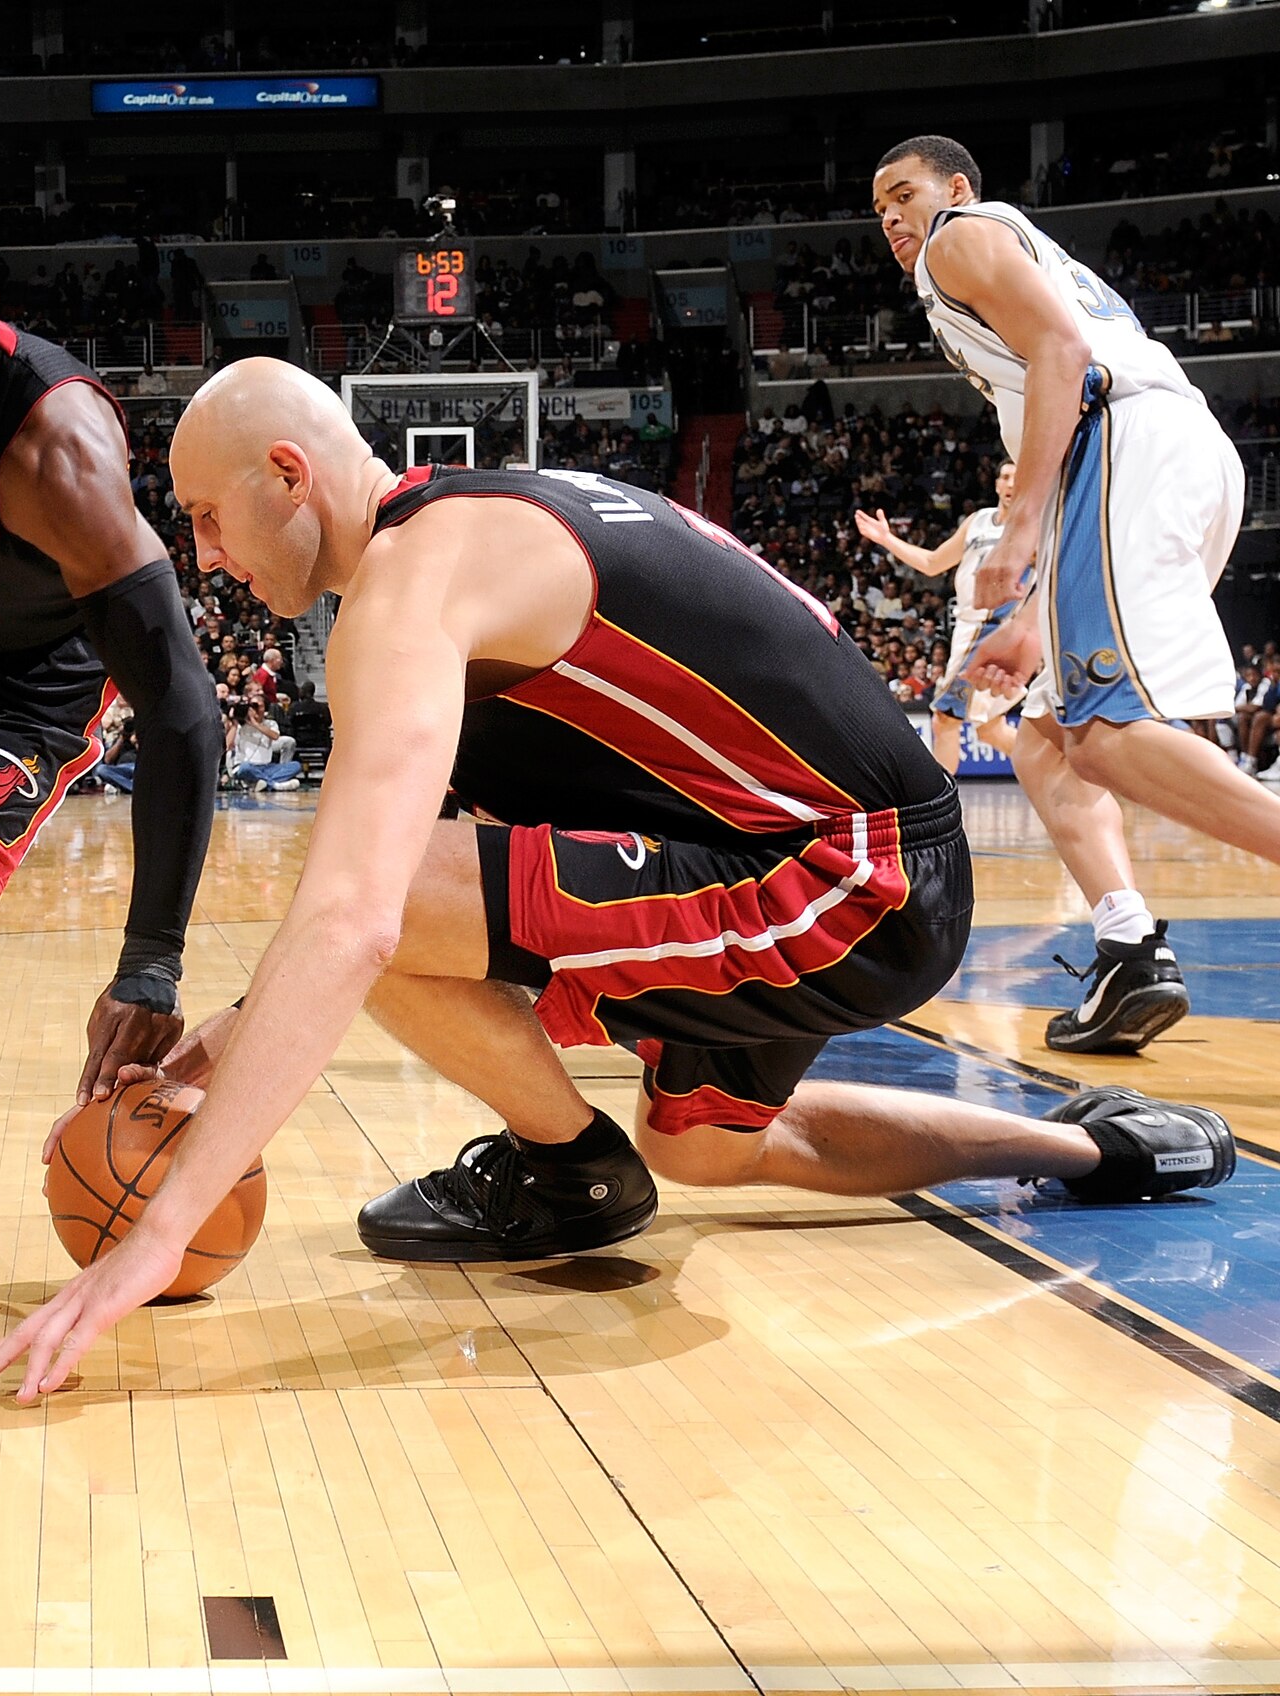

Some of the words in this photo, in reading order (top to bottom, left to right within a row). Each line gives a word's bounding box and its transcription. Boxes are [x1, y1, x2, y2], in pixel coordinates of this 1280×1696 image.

[608, 240, 637, 254] 105
[736, 232, 765, 247] 104
[292, 247, 321, 261] 105
[417, 251, 464, 274] 6:53
[427, 274, 458, 315] 12
[211, 302, 240, 318] 106
[256, 321, 288, 336] 105
[381, 398, 483, 419] BLATHE'S
[513, 397, 577, 418] BNCH
[630, 394, 663, 411] 105
[1159, 1155, 1201, 1166] WITNESS
